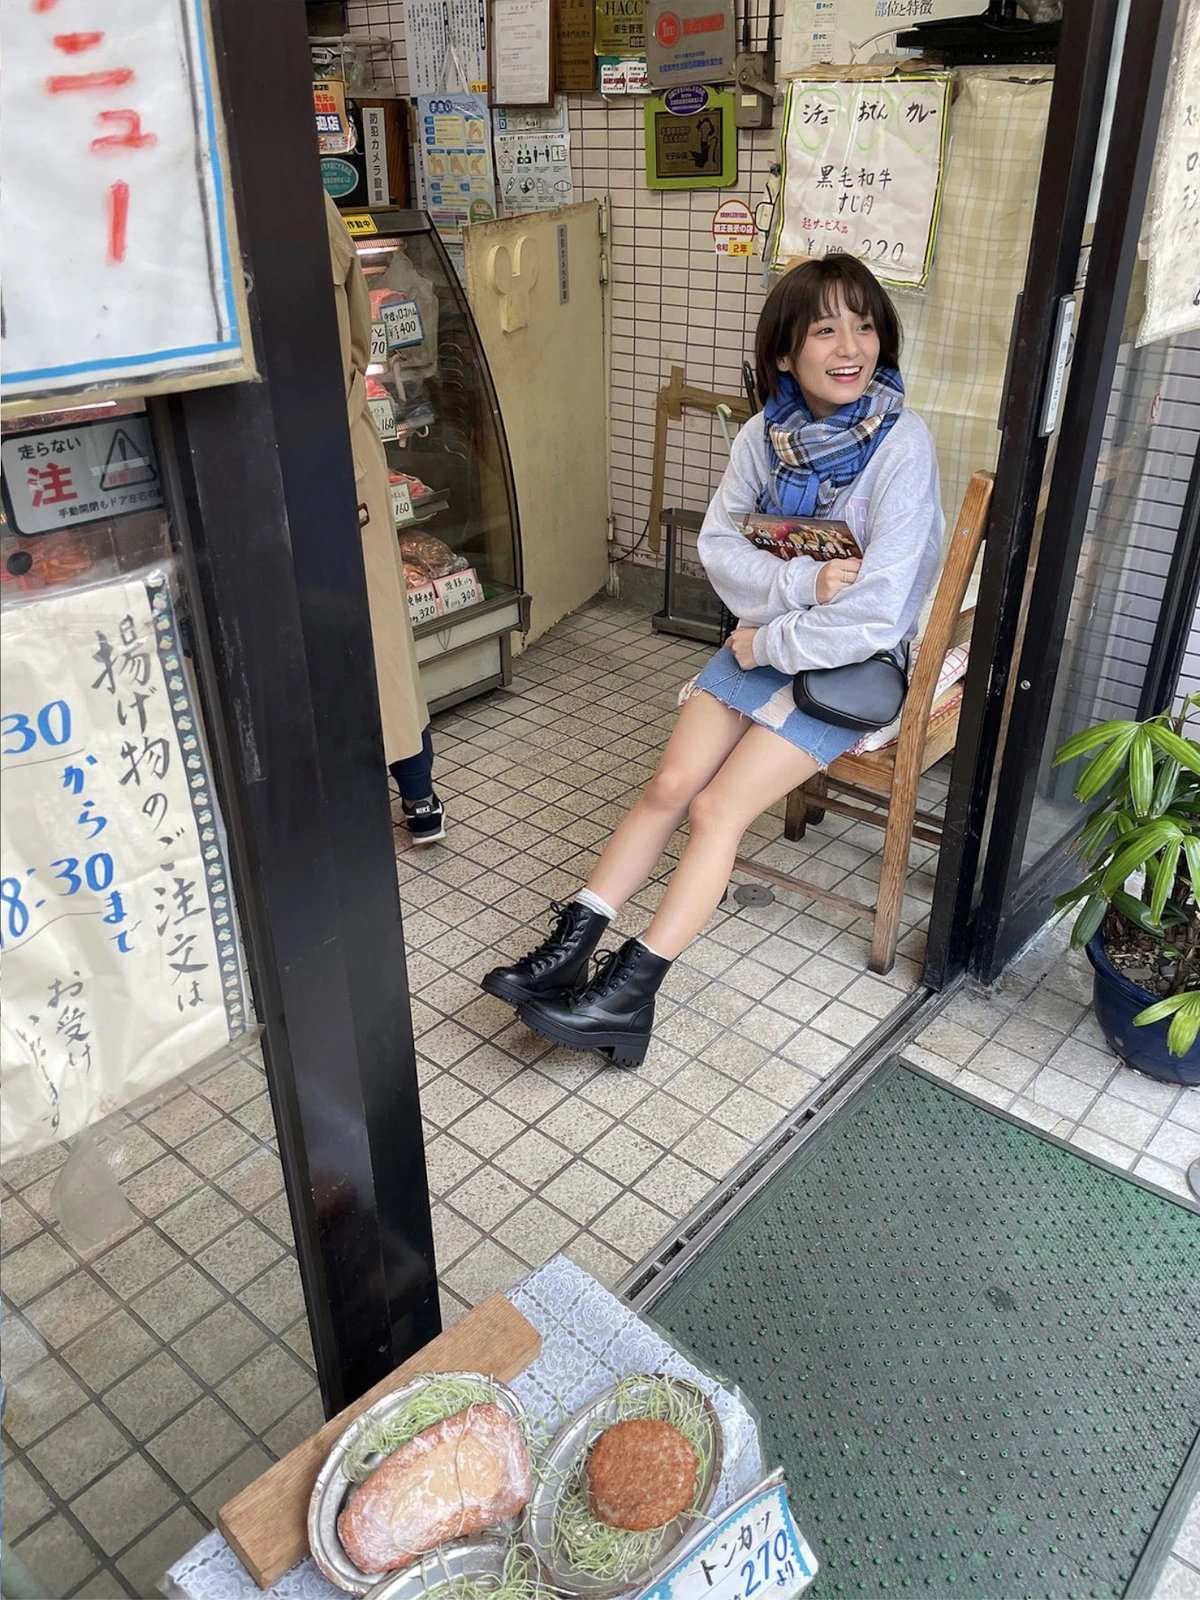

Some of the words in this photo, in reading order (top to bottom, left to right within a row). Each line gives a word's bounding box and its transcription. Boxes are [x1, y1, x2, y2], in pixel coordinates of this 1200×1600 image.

[875, 0, 933, 17] 部位と特徴
[802, 103, 836, 125] シチュー
[858, 101, 889, 121] おでん
[905, 102, 937, 124] カレー
[369, 113, 383, 201] 防犯カメラ設置
[816, 165, 893, 190] 黒毛和牛
[838, 193, 875, 215] すじ肉
[733, 243, 748, 254] 2年
[857, 239, 904, 263] 220
[400, 320, 416, 339] 400
[381, 418, 395, 430] 160
[18, 437, 82, 461] 走らない
[27, 463, 78, 507] 注
[395, 501, 410, 516] 160
[754, 537, 820, 552] CALENDAR
[461, 588, 476, 603] 300
[419, 605, 436, 619] 320
[60, 754, 108, 840] から
[415, 804, 431, 814] NIKE
[91, 613, 208, 1013] 揚げ物のご注文は
[102, 889, 143, 953] まで
[47, 970, 91, 1075] お受け
[700, 1510, 771, 1587] トンカツ
[740, 1528, 788, 1597] 270
